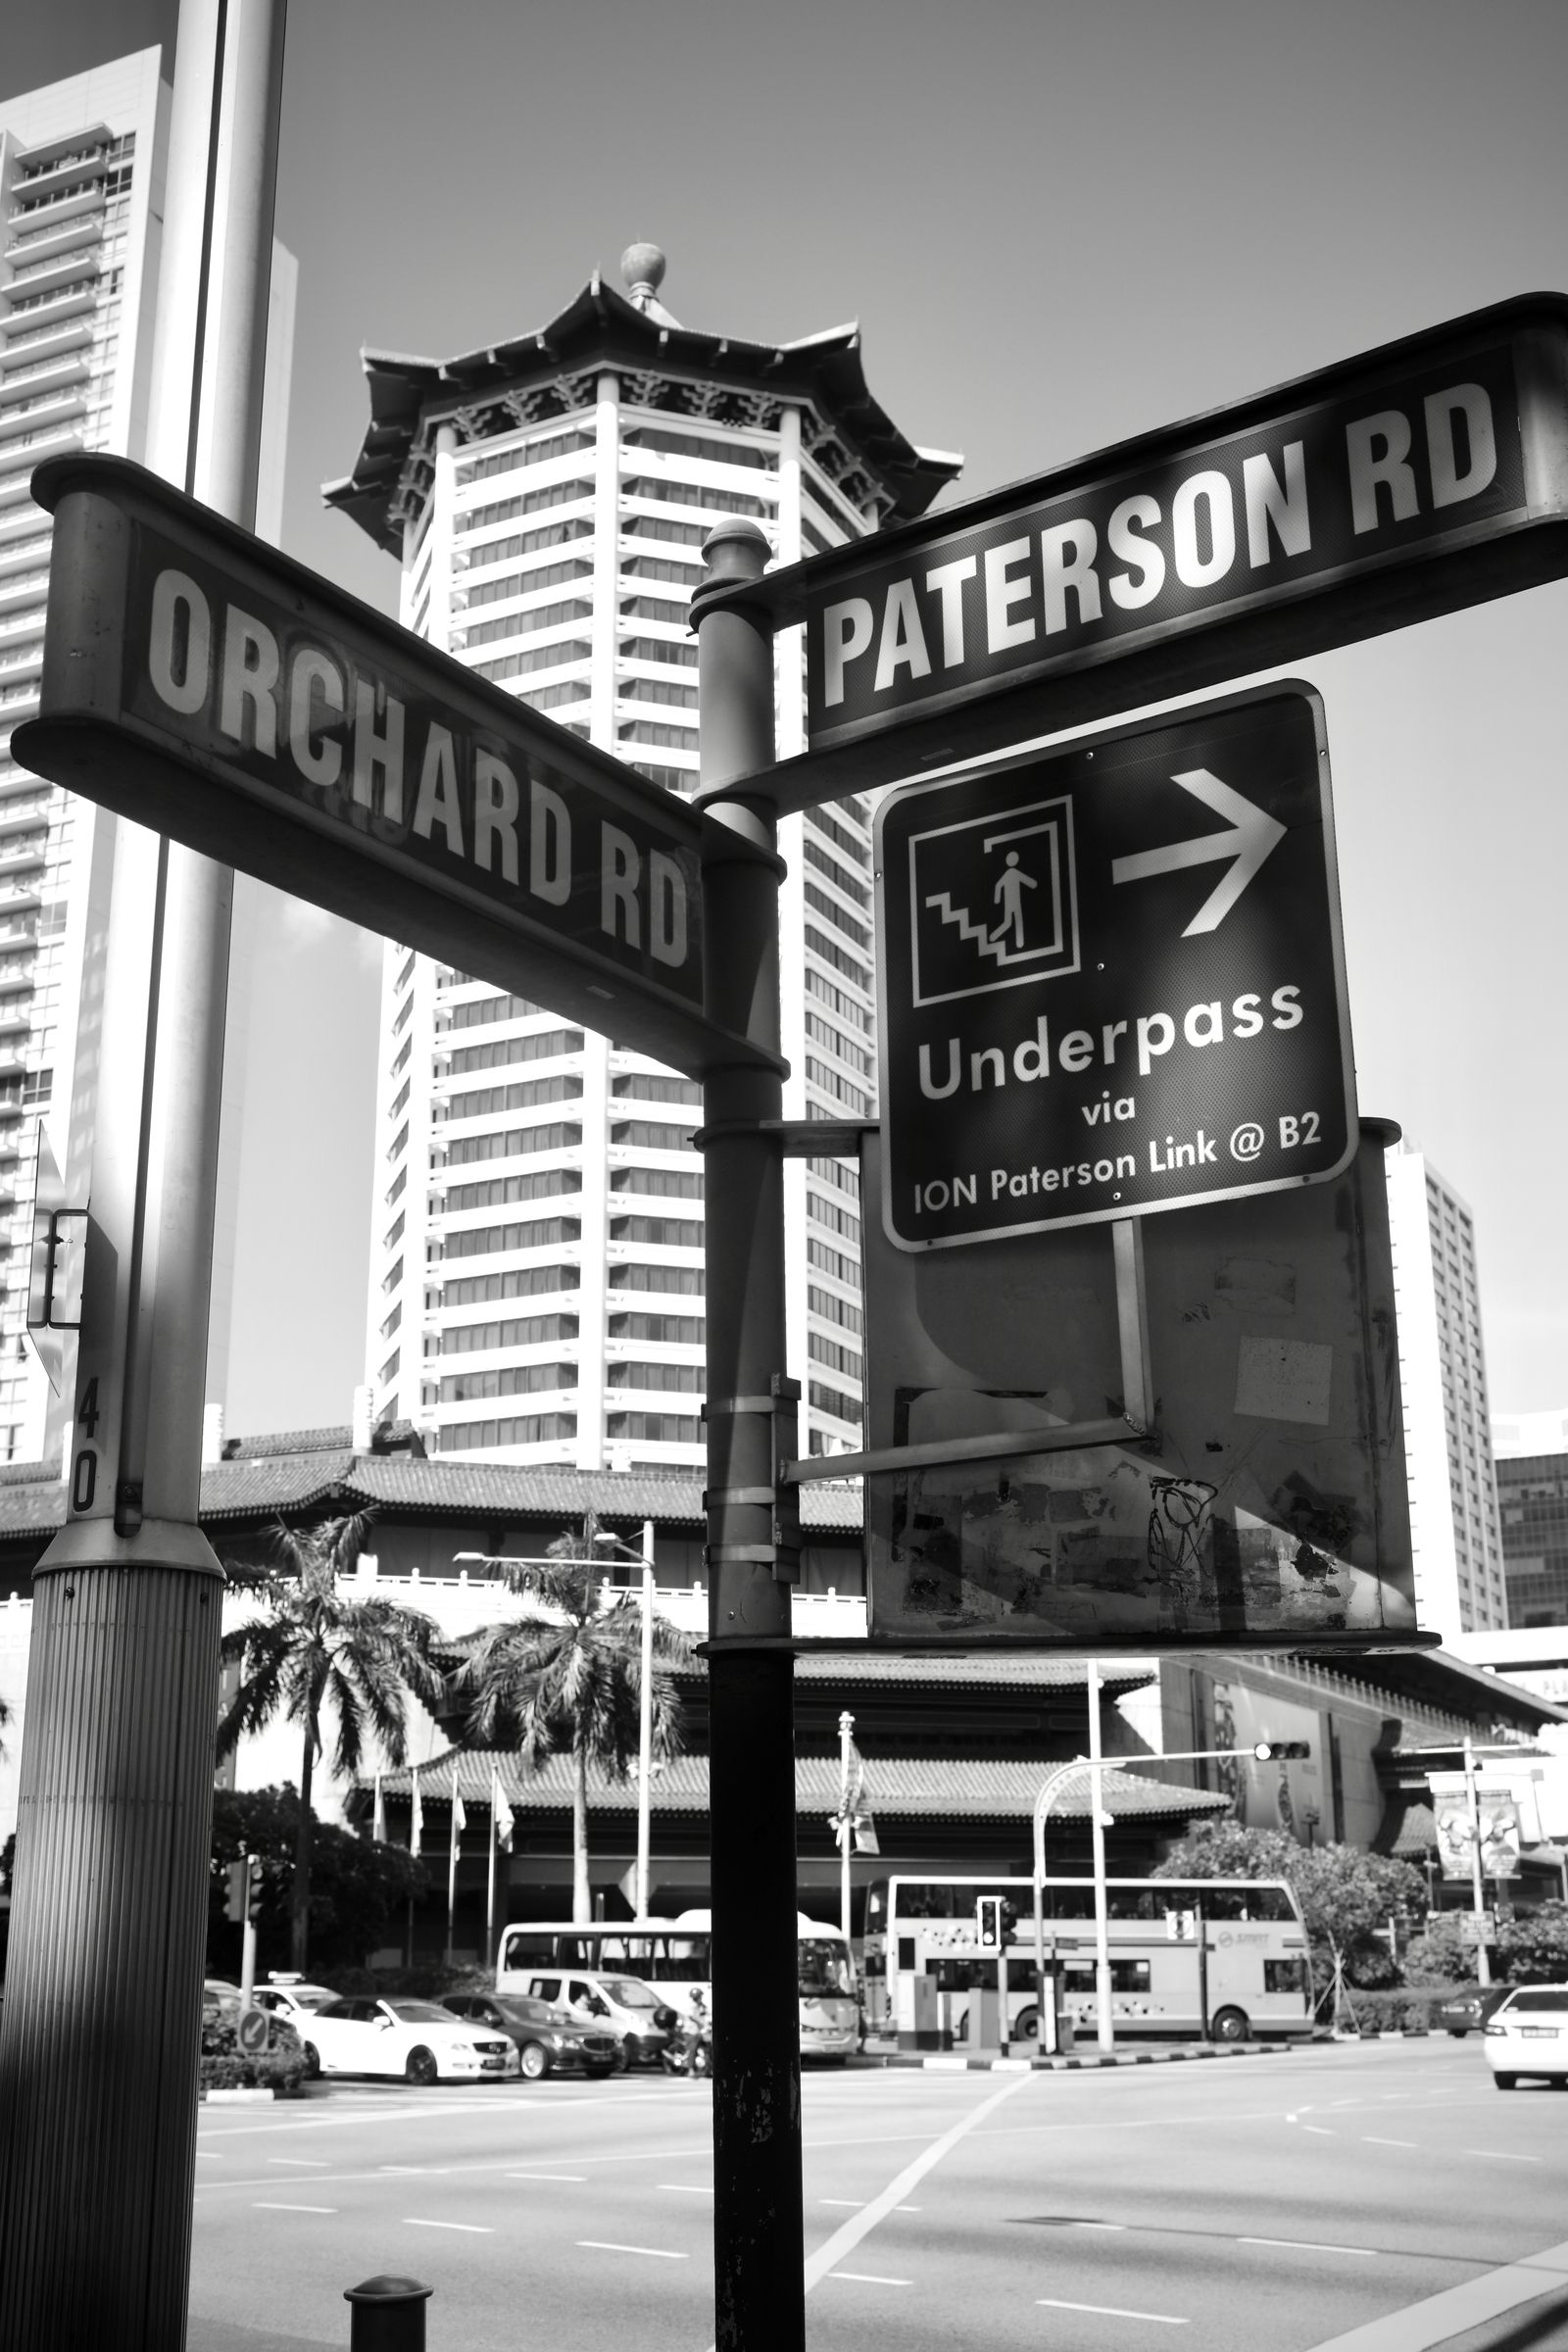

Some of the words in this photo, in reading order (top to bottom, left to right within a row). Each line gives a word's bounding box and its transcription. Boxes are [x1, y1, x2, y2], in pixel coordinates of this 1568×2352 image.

[823, 440, 1312, 709] PATERSON
[1345, 382, 1498, 536] RD
[148, 568, 572, 907] ORCHARD
[600, 819, 688, 969] RD
[917, 984, 1304, 1101] Underpass
[914, 1174, 977, 1214] ION
[992, 1154, 1136, 1200] Paterson
[1149, 1131, 1217, 1173] Link
[1230, 1122, 1266, 1162] @
[1278, 1111, 1322, 1150] B2
[1081, 1090, 1136, 1126] via
